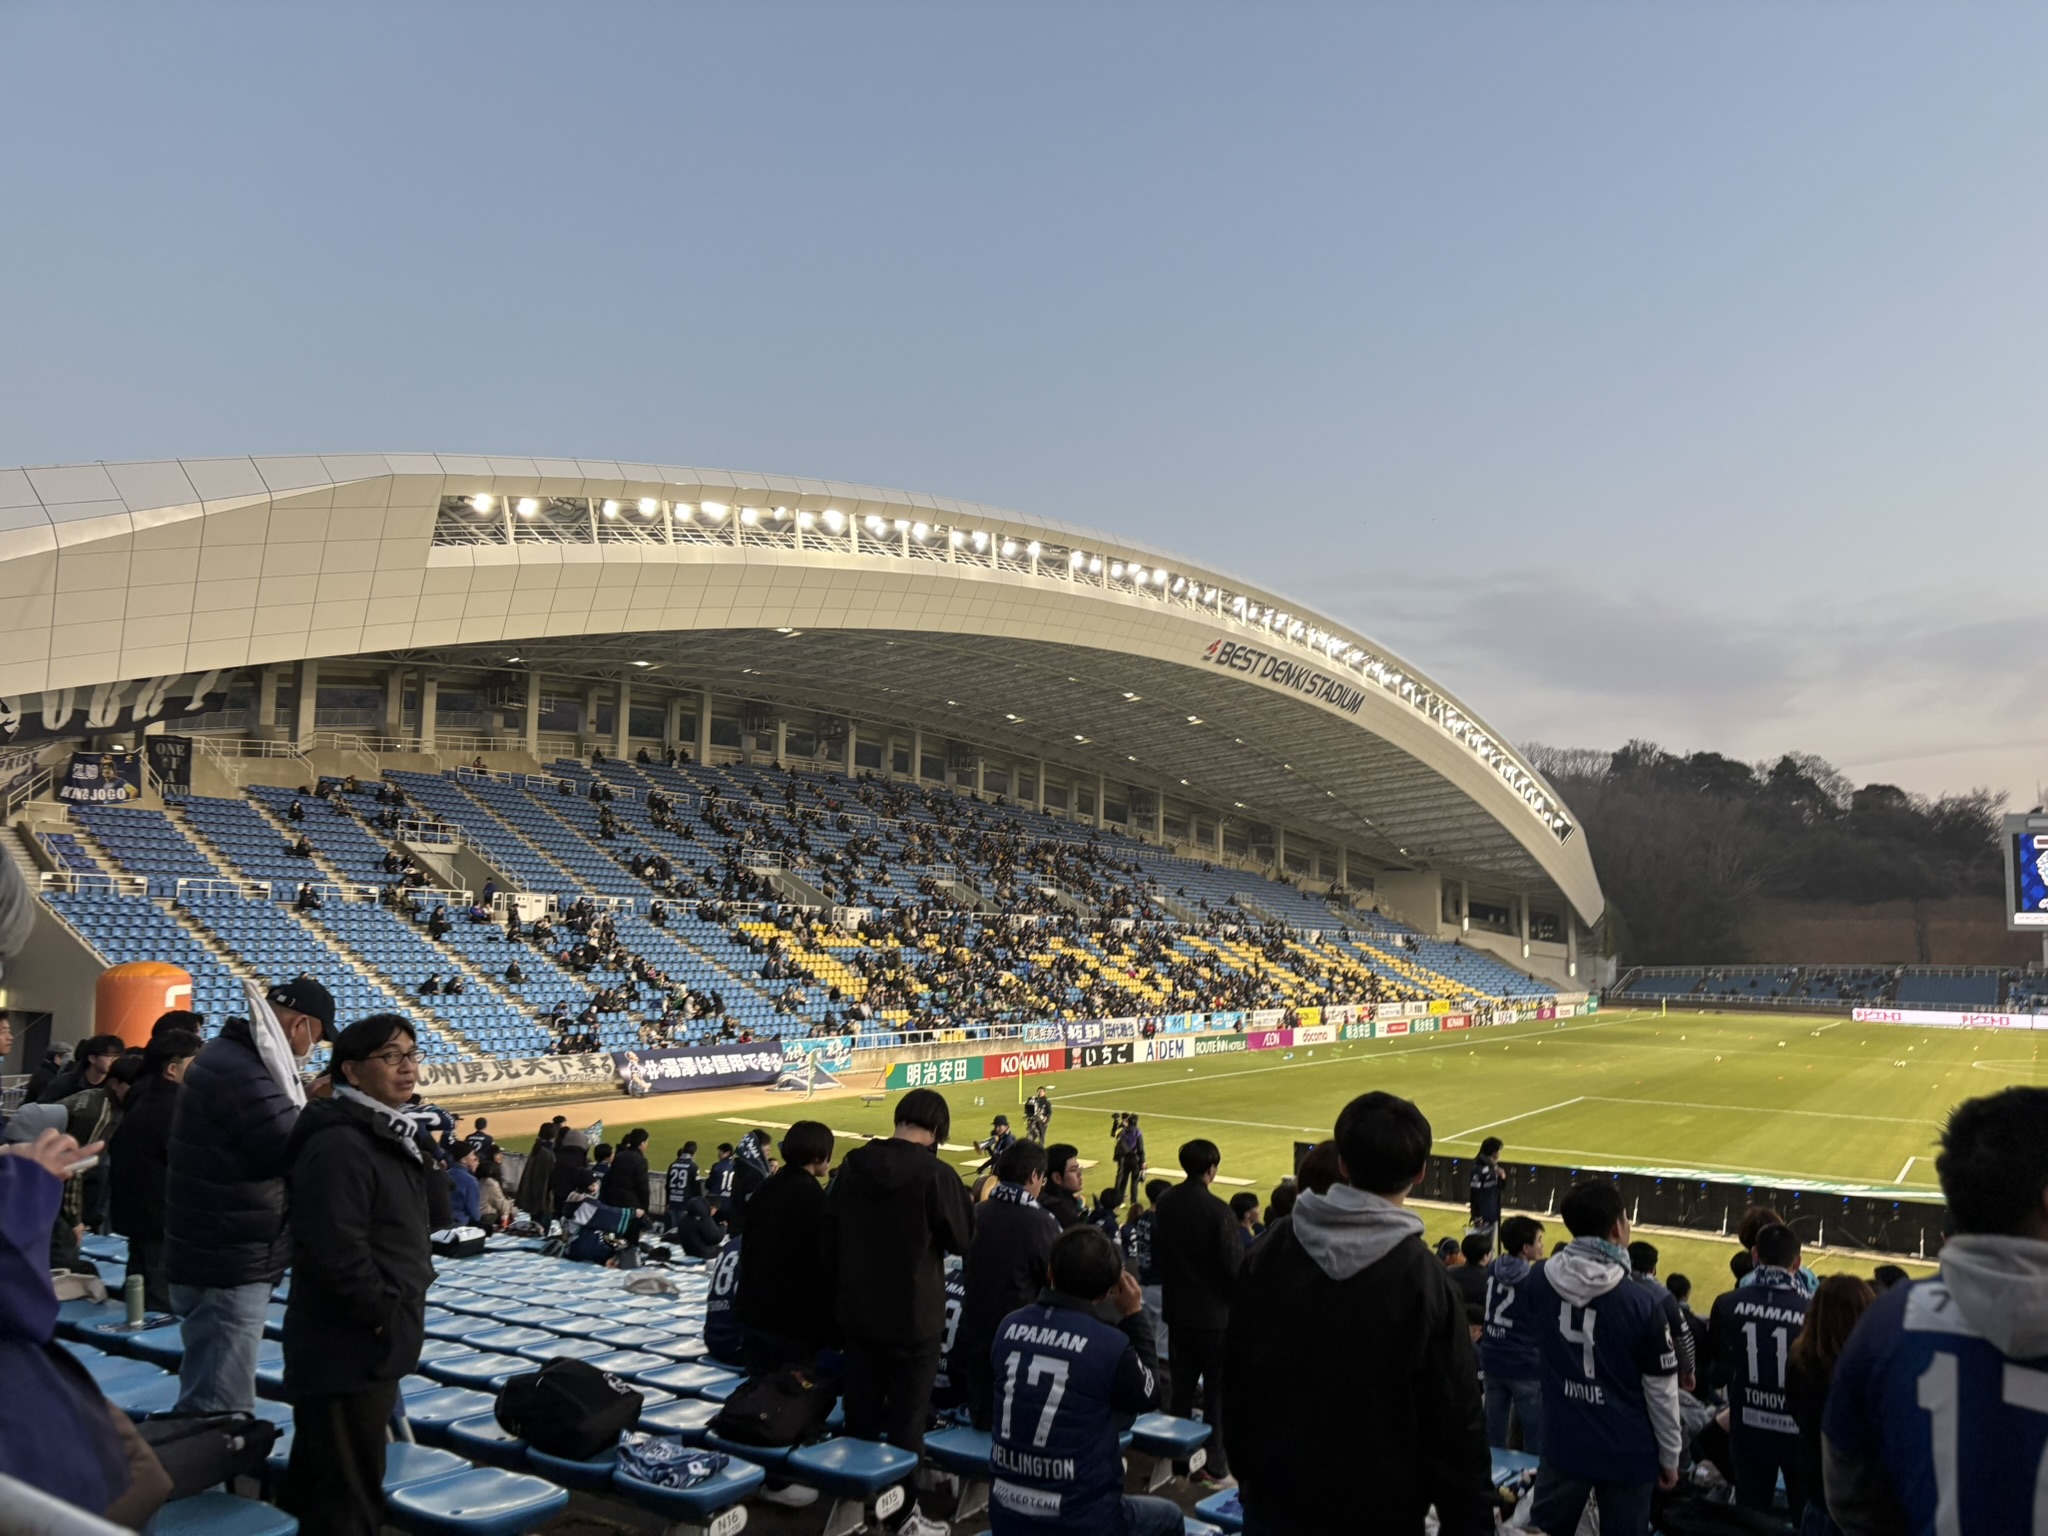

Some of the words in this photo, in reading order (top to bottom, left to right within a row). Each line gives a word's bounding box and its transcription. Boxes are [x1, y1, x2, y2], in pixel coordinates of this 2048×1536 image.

[1216, 641, 1267, 674] BEST
[1261, 656, 1312, 690] DENKI
[1305, 673, 1366, 715] STADIUM
[155, 743, 186, 757] ONE
[165, 770, 176, 782] A
[90, 787, 127, 801] JOGO
[1229, 1040, 1246, 1051] HOTELS
[1303, 1031, 1328, 1043] docomo
[1000, 1053, 1050, 1074] KONAMI
[1085, 1043, 1128, 1067] いちご
[906, 1058, 968, 1086] 明治安田
[669, 1168, 689, 1190] 29
[1484, 1275, 1516, 1328] 12
[1734, 1301, 1806, 1326] APAMAN
[1004, 1322, 1088, 1353] APAMAN
[1558, 1301, 1597, 1380] 4
[1741, 1321, 1788, 1389] 11
[1001, 1350, 1070, 1448] 17
[1564, 1377, 1605, 1405] INOUE
[717, 1510, 739, 1532] N16
